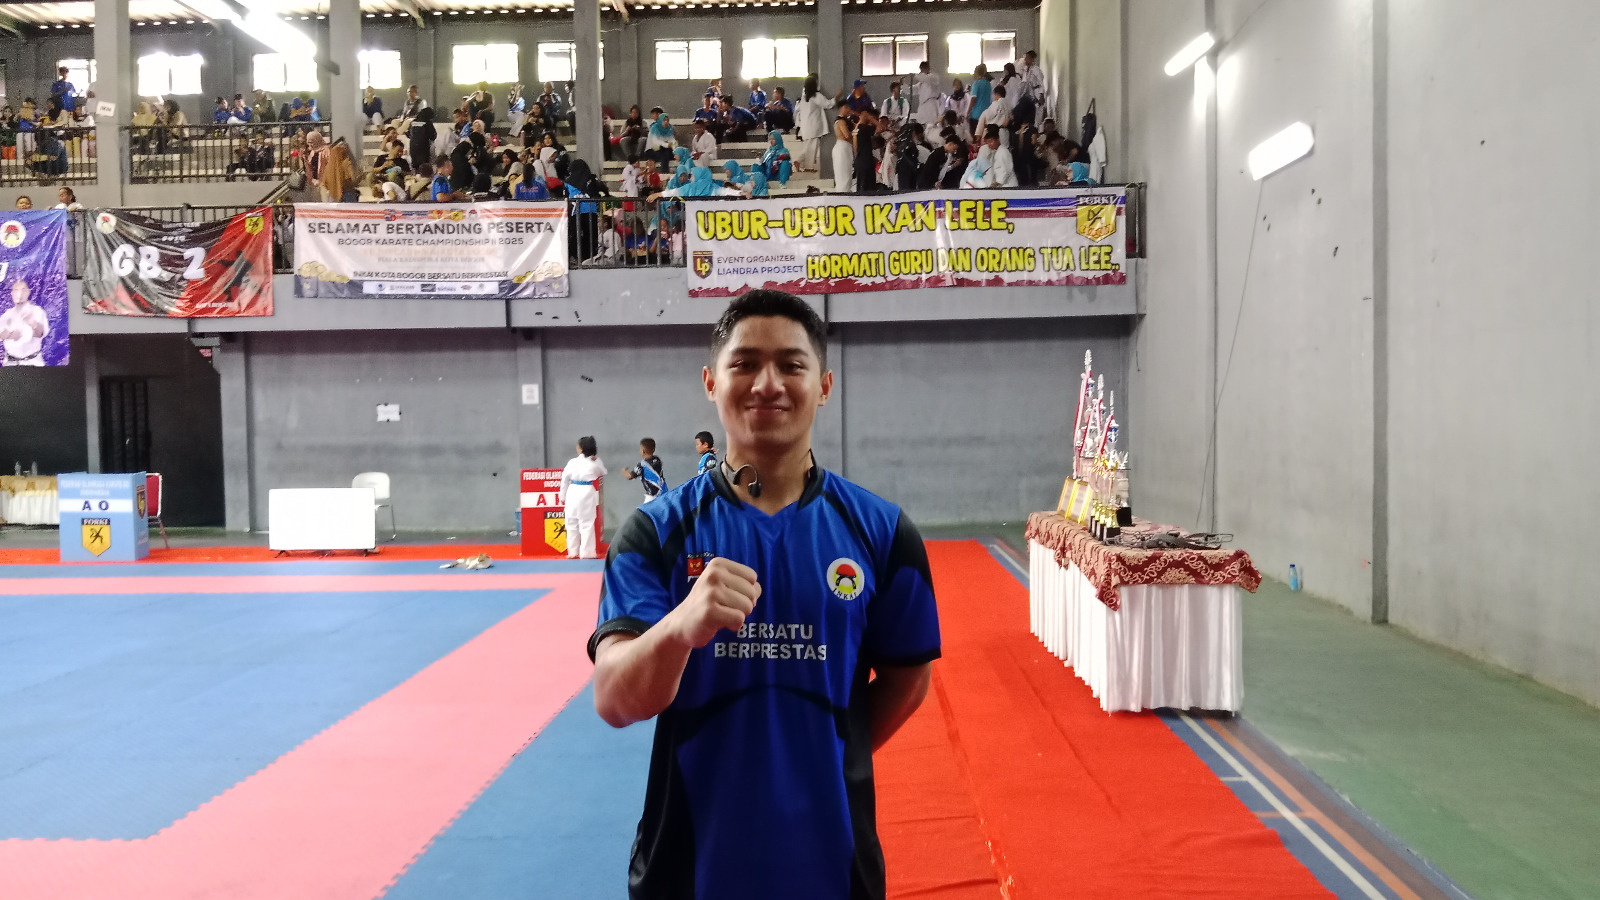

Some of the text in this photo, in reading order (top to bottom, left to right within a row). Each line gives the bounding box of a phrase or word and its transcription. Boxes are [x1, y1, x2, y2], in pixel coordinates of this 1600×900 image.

[696, 199, 1015, 241] UBUR-UBUR IKAN LELE,
[308, 222, 555, 235] SELAMAT BERTANDING PESERTA
[338, 238, 373, 246] BOGOR
[375, 238, 413, 246] KARATE
[416, 238, 490, 246] CHAMPIONSHIP
[499, 237, 524, 245] 2025
[182, 246, 206, 279] 2
[717, 255, 795, 264] EVENT ORGANIZER
[806, 252, 885, 280] HORMATI
[889, 249, 933, 276] GURU
[937, 247, 971, 273] DAN
[975, 246, 1036, 273] ORANG
[1039, 246, 1075, 272] TUA
[717, 265, 804, 275] LIANDRA PROJECT
[737, 622, 813, 640] BERSATU
